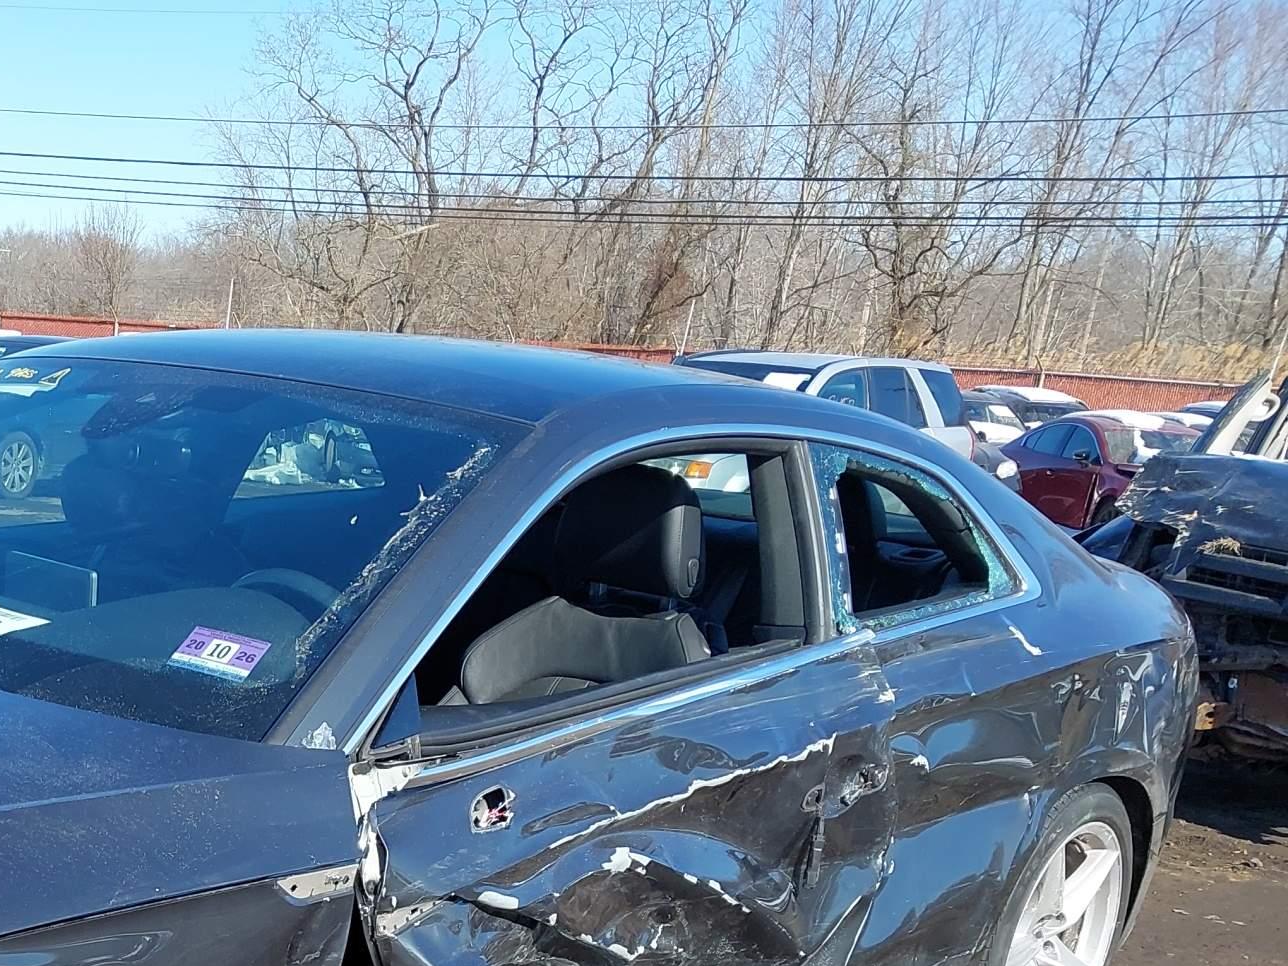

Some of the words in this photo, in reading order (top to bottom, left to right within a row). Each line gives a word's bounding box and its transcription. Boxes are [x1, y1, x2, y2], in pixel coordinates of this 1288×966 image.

[185, 639, 206, 651] 20
[206, 643, 232, 660] 10
[234, 651, 257, 664] 26
